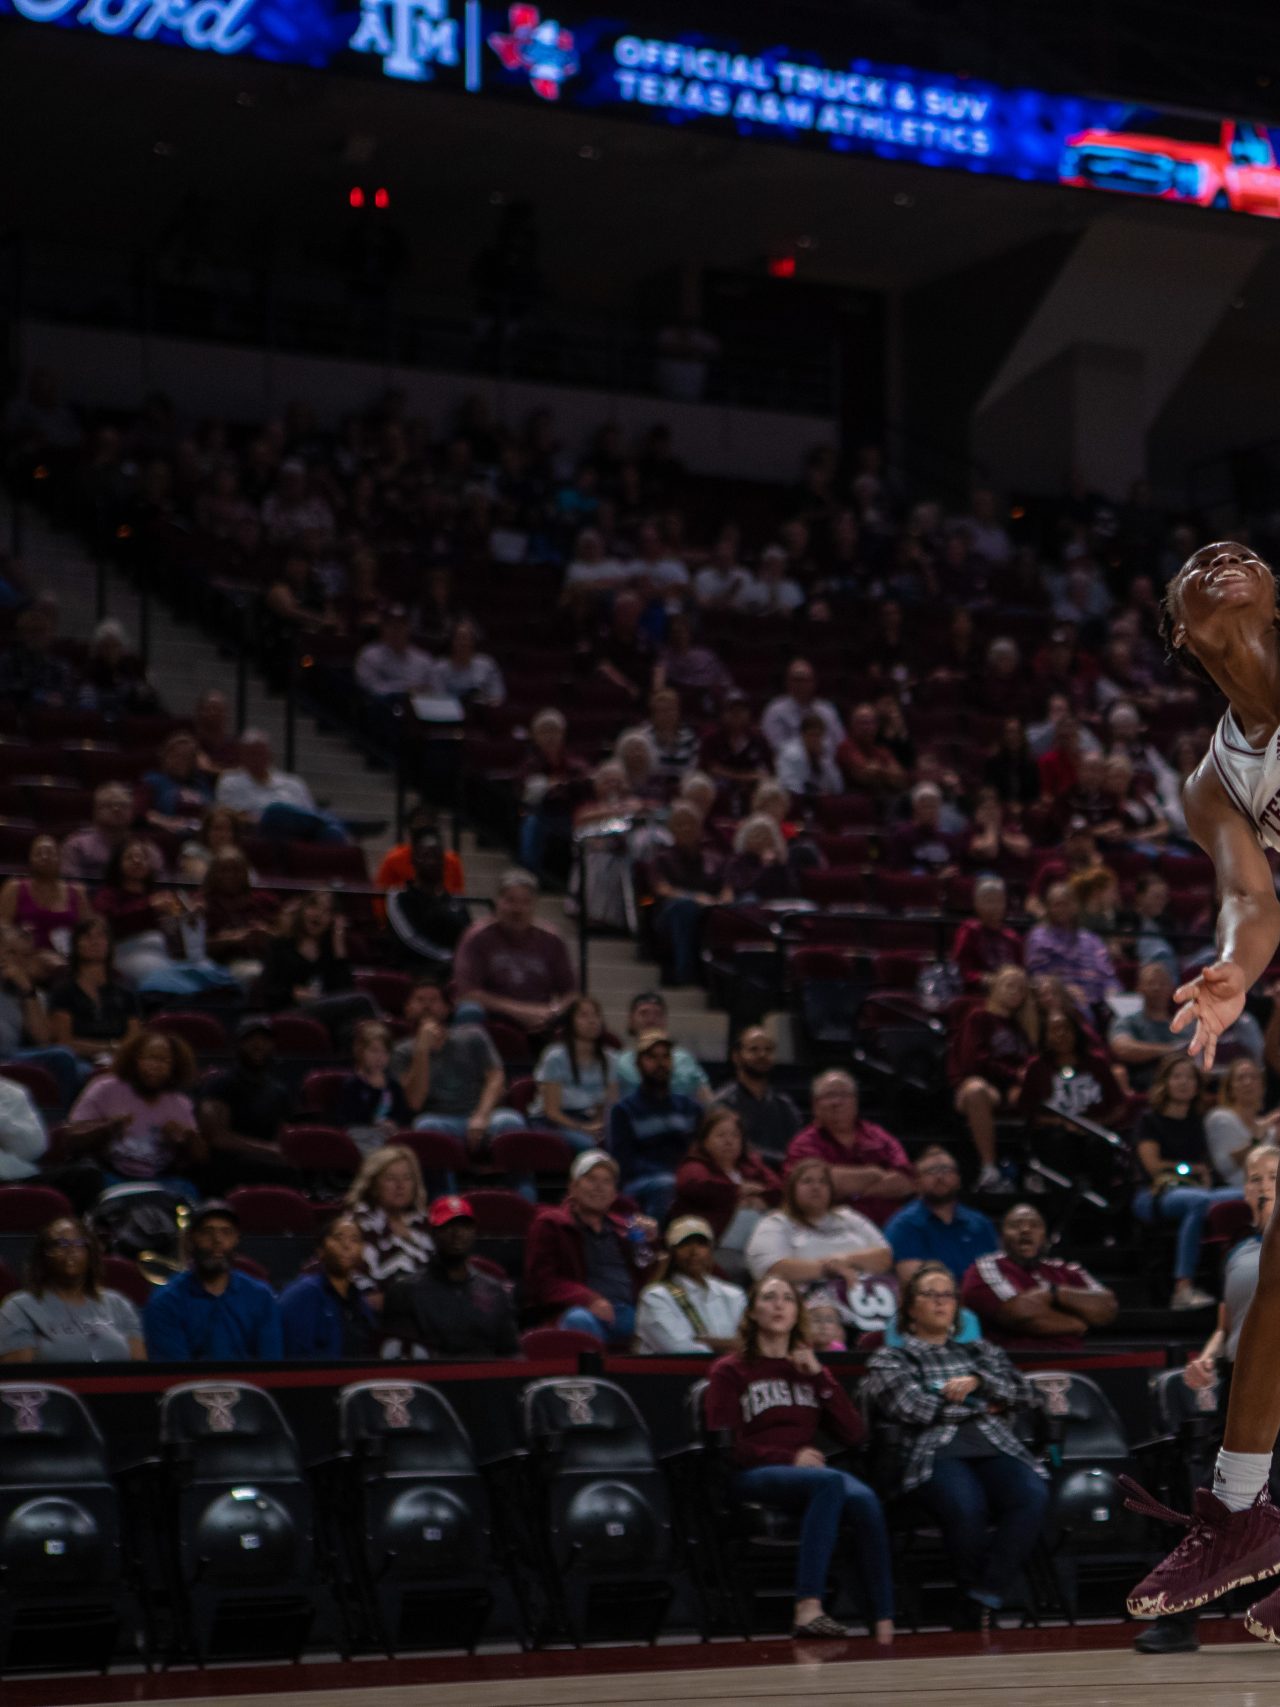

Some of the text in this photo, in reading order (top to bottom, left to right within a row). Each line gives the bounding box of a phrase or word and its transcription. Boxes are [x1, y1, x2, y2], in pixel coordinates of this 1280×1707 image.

[613, 34, 989, 122] OFFICIAL TRUCK & SUV
[613, 68, 1001, 157] TEXAS A&M ATHLETICS
